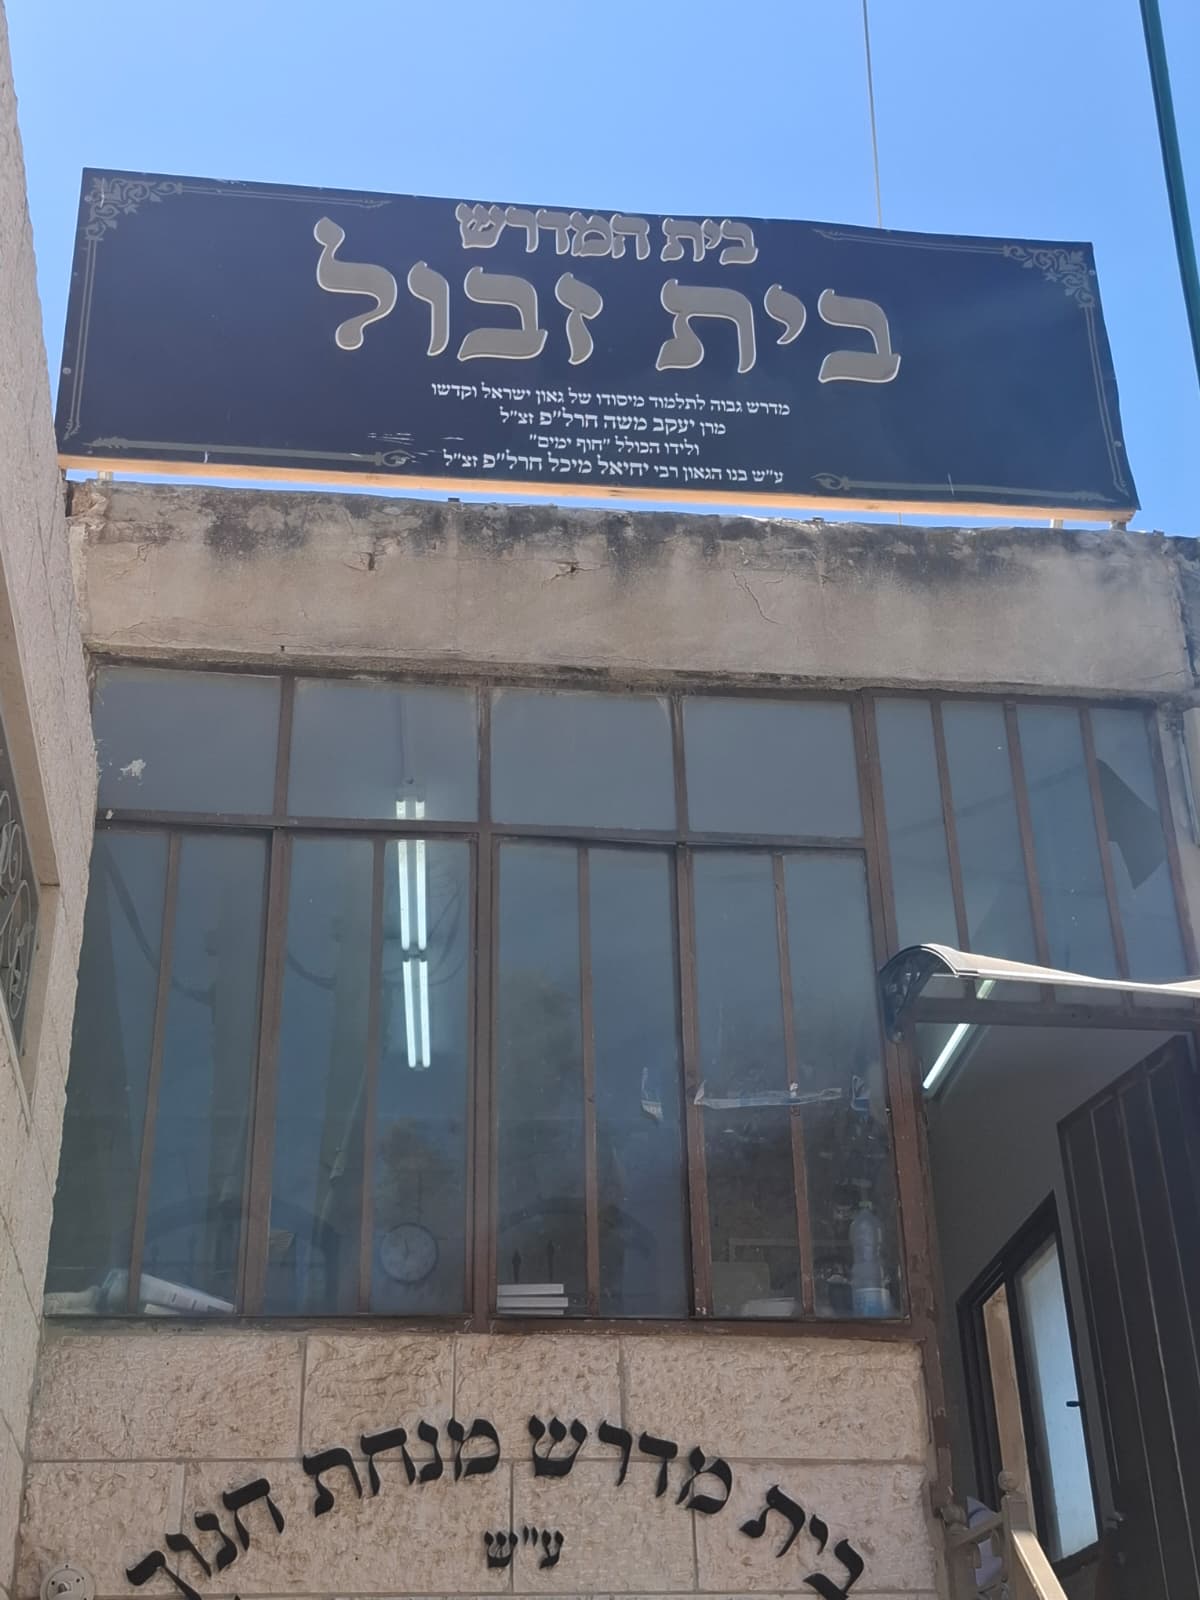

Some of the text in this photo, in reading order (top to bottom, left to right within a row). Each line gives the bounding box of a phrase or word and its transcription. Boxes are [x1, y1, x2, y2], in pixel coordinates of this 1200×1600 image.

[455, 202, 758, 264] בית המדרש
[313, 217, 900, 383] בית זבול
[431, 381, 791, 416] מדרש גבוה לתלמוד מיסודו של גאון ישראל וקדשו
[603, 414, 648, 431] משה
[652, 416, 696, 436] יעקב
[699, 421, 727, 437] מרן
[614, 434, 661, 454] הכולל
[663, 437, 700, 456] ולידו
[546, 450, 593, 474] מיכל
[596, 453, 650, 477] יחיאל
[653, 464, 679, 479] רבי
[682, 465, 723, 482] הגאון
[725, 468, 748, 482] בנו
[126, 1414, 865, 1600] בית מדרש מנחת חנוך
